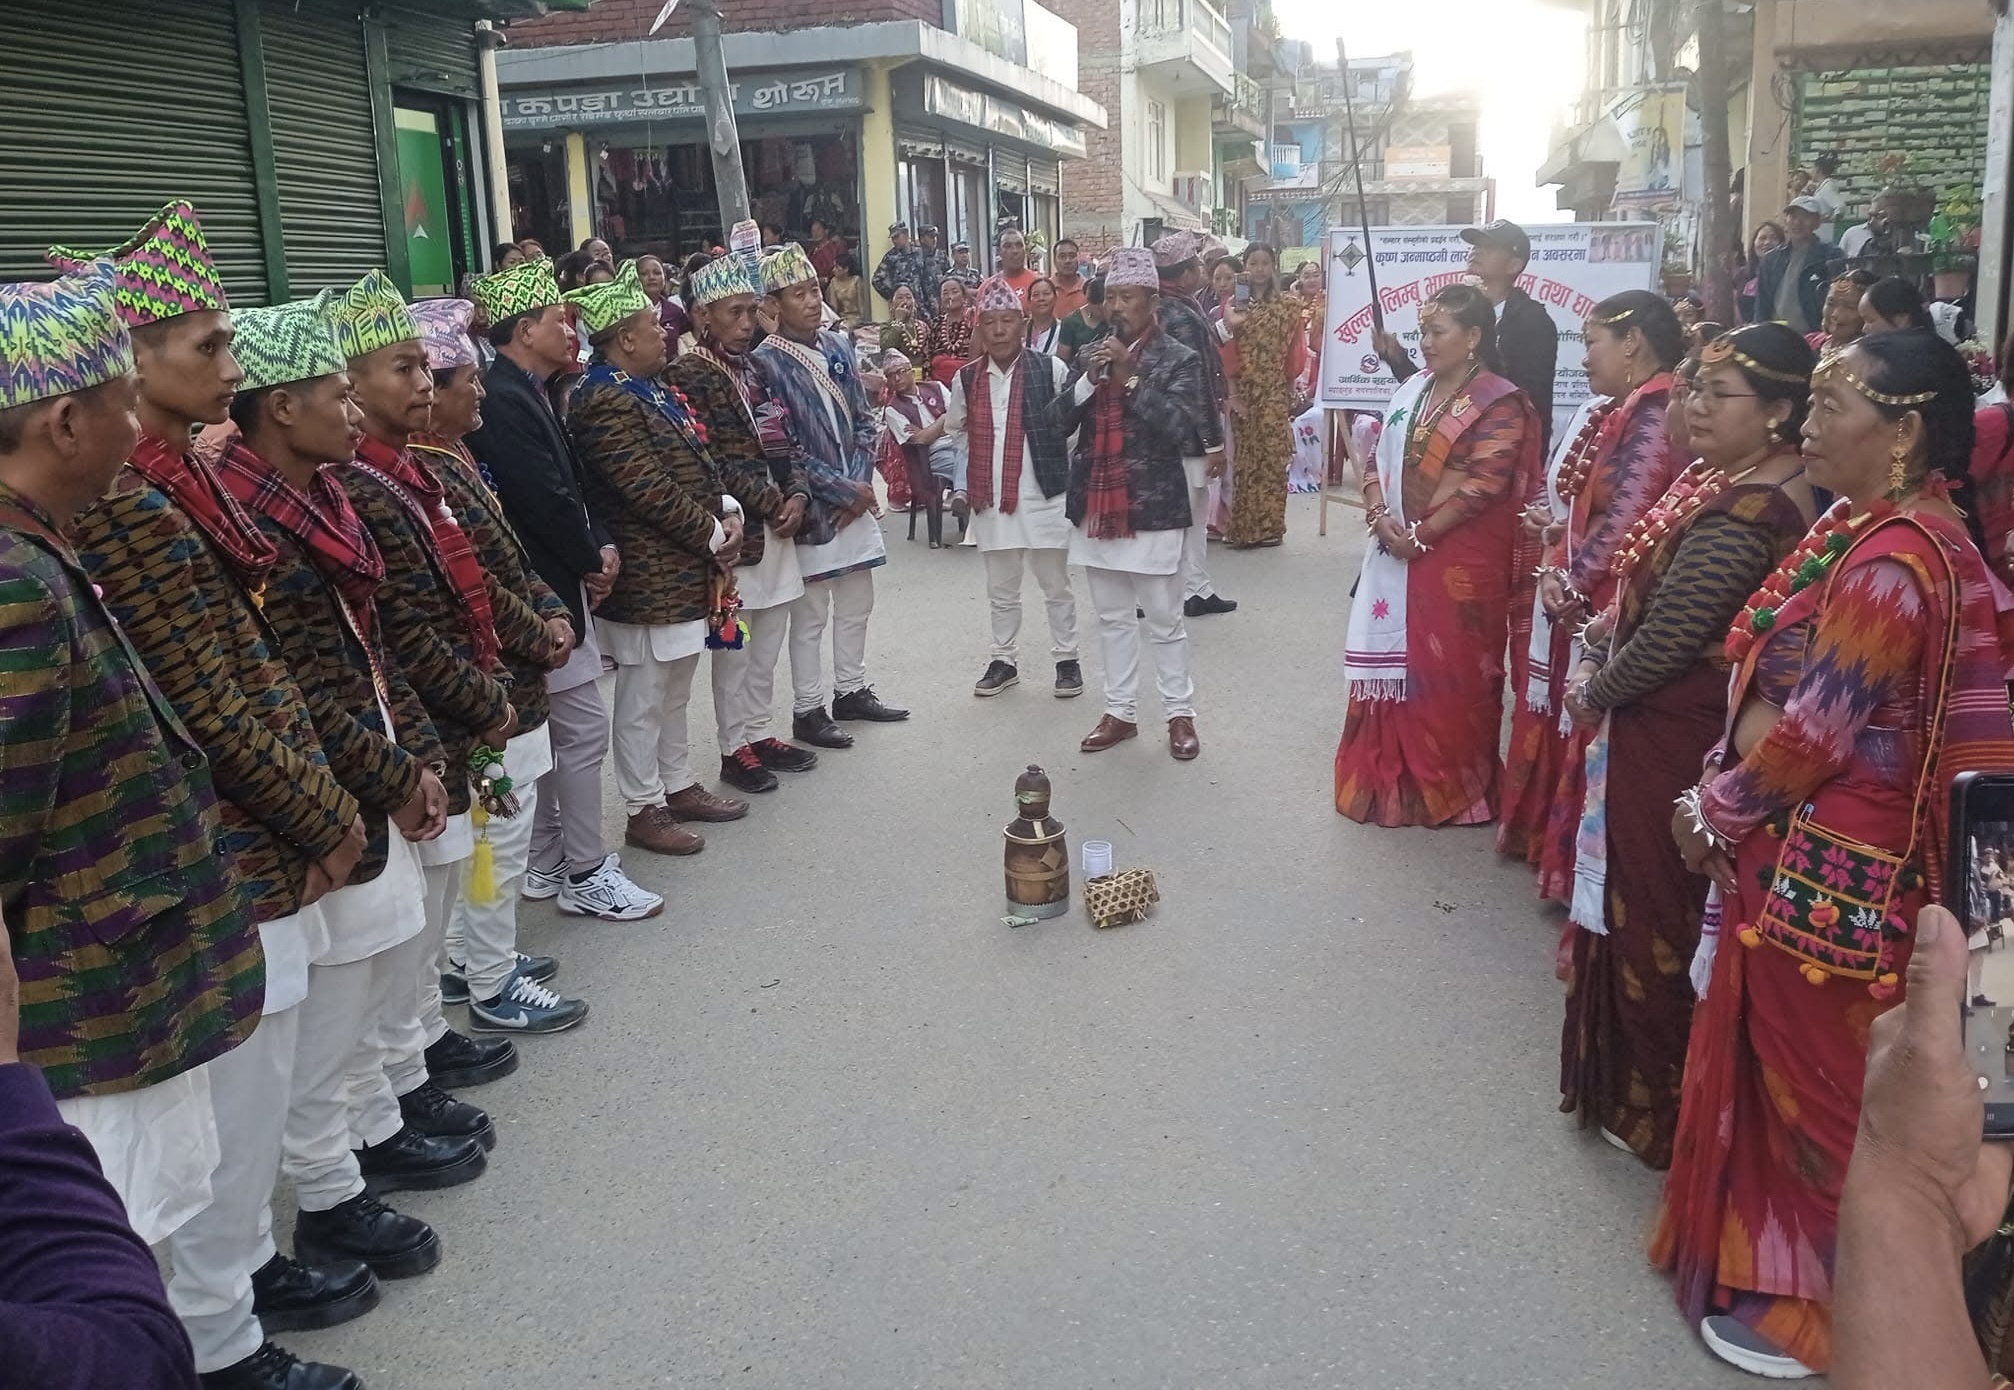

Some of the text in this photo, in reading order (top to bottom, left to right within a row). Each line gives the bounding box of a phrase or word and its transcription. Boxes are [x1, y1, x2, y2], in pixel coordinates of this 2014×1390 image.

[630, 81, 740, 107] उद्यो
[1376, 251, 1399, 266] कृष्ण
[1333, 303, 1376, 344] खुल्ल
[1379, 279, 1423, 315] लिम्बु
[1538, 278, 1574, 309] तथा
